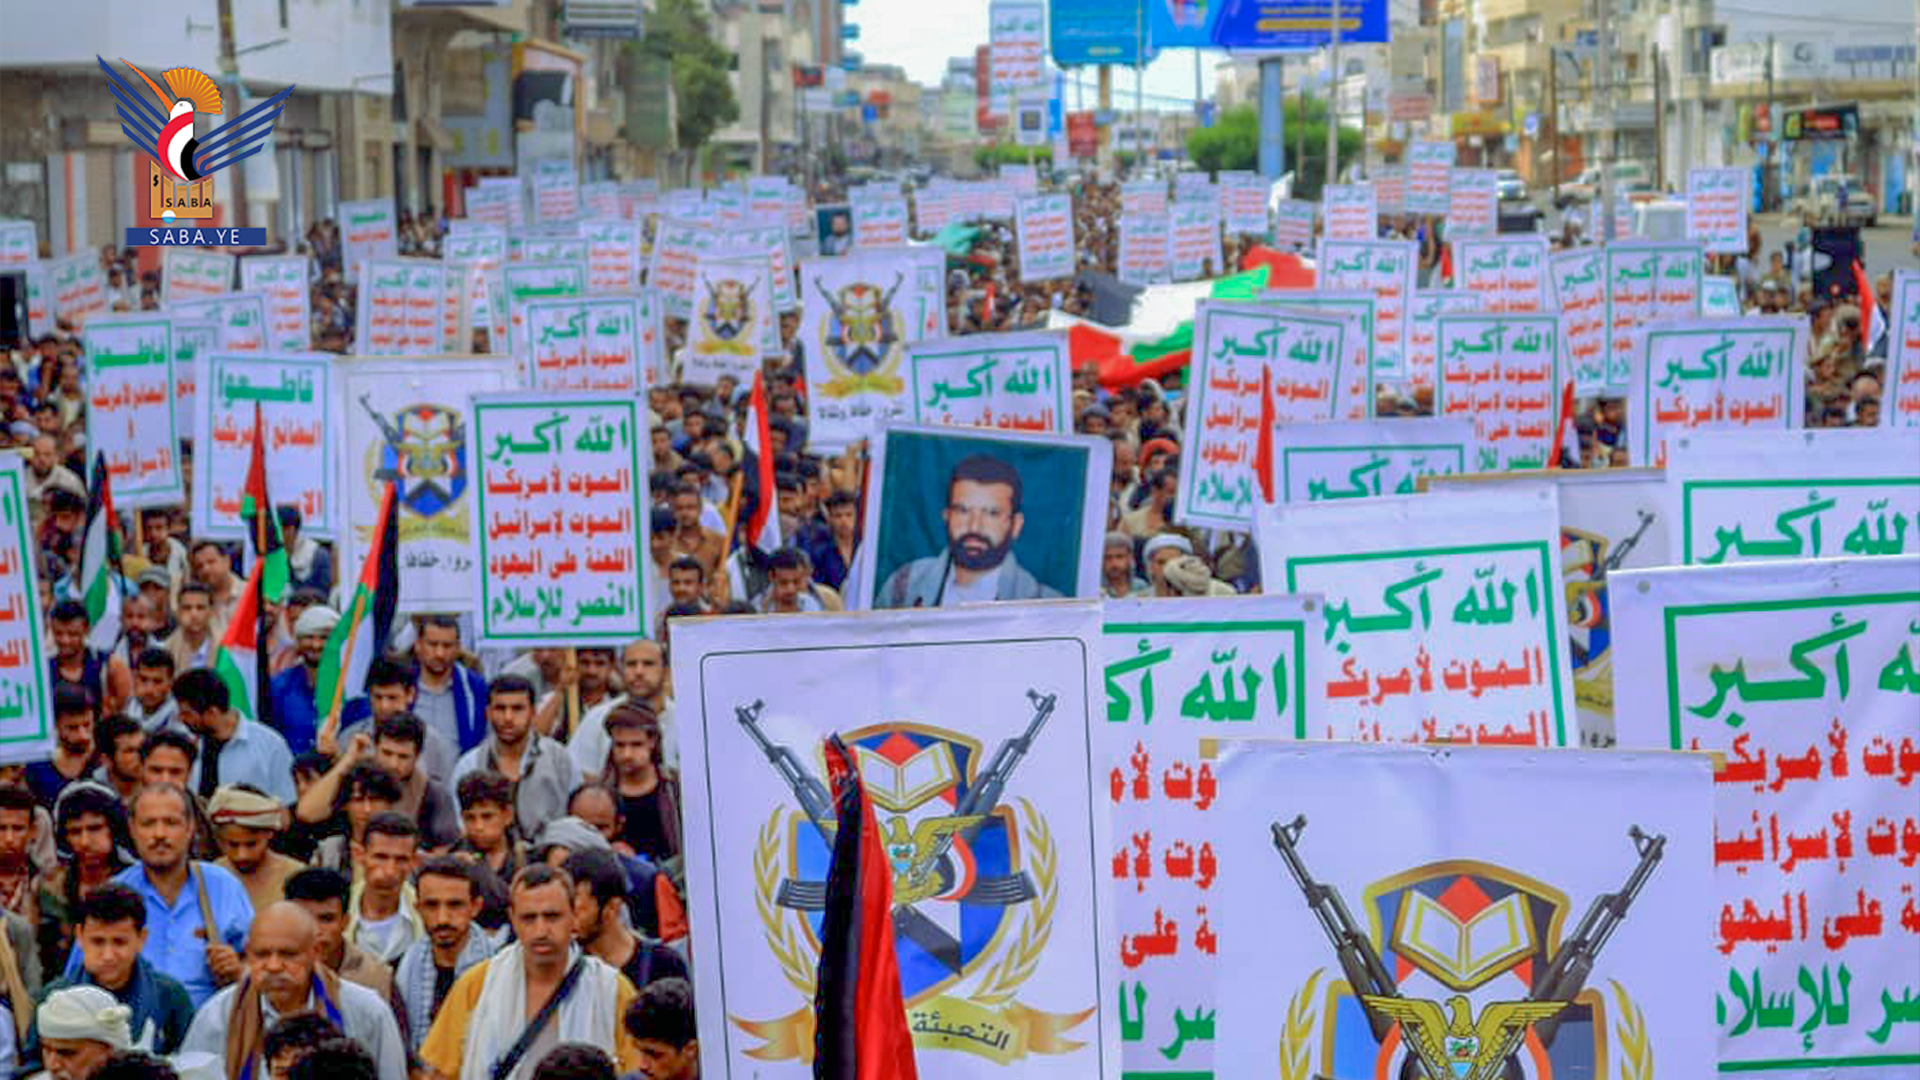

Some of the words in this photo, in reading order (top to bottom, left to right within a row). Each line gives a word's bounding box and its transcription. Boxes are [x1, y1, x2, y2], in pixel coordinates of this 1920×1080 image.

[539, 309, 589, 348] أكبر
[596, 311, 630, 337] الله
[1212, 322, 1290, 365] أكبر
[1445, 320, 1510, 362] أكبر
[1511, 325, 1551, 353] الله
[1287, 330, 1334, 365] الله
[1655, 334, 1737, 394] أكبر
[1736, 340, 1785, 380] الله
[924, 355, 999, 412] أكبر
[1004, 357, 1052, 396] الله
[1276, 378, 1330, 403] الموت
[1444, 360, 1502, 387] لأمريكا
[1504, 362, 1552, 386] الموت
[1504, 390, 1552, 414] الموت
[1654, 391, 1727, 429] لأمريكا
[1728, 393, 1784, 424] الموت
[485, 411, 570, 467] أكبر
[574, 415, 629, 452] الله
[486, 464, 562, 500] لأمريكا
[568, 467, 631, 498] الموت
[488, 506, 564, 542] لإسرائيل
[568, 507, 632, 539] الموت
[488, 547, 543, 581] اليهود
[549, 548, 578, 580] على
[585, 545, 634, 574] اللعنة
[490, 585, 564, 630] للإسلام
[569, 582, 635, 627] النصر
[1322, 560, 1444, 656] أكبر
[1452, 565, 1539, 626] الله
[1102, 639, 1173, 726] أك
[1180, 647, 1288, 723] الله
[1325, 643, 1434, 708] لأمريك
[1442, 646, 1545, 699] الموت
[1687, 611, 1869, 728] أكبر
[1690, 717, 1851, 794] لأمريك
[1713, 809, 1854, 874] لإسرائي
[1120, 905, 1179, 968] على
[1715, 889, 1808, 955] اليهو
[1822, 886, 1883, 951] على
[911, 1010, 1011, 1051] التعبئة
